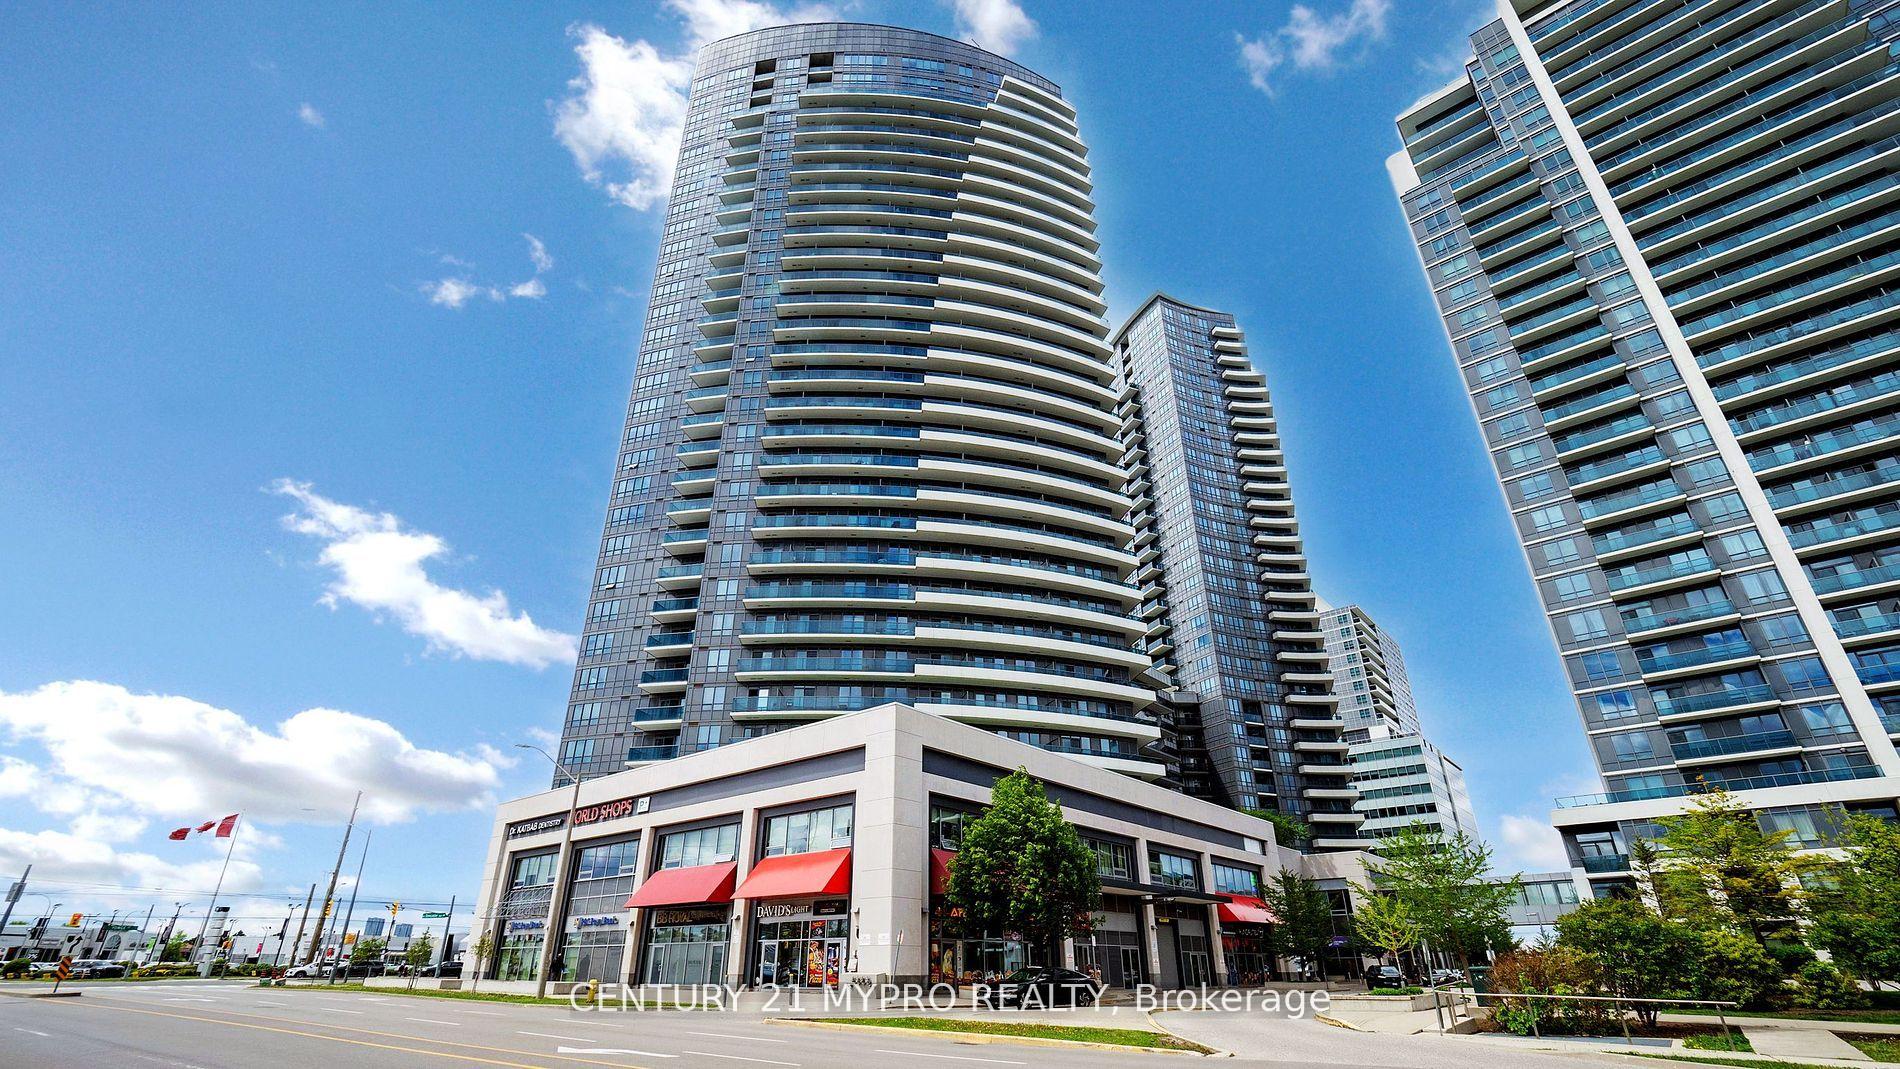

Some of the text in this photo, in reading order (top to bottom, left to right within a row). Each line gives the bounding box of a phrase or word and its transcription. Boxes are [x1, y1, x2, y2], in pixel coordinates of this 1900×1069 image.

[573, 807, 599, 825] ORLD
[599, 800, 632, 819] SHOPS
[756, 904, 791, 918] DAVID'S
